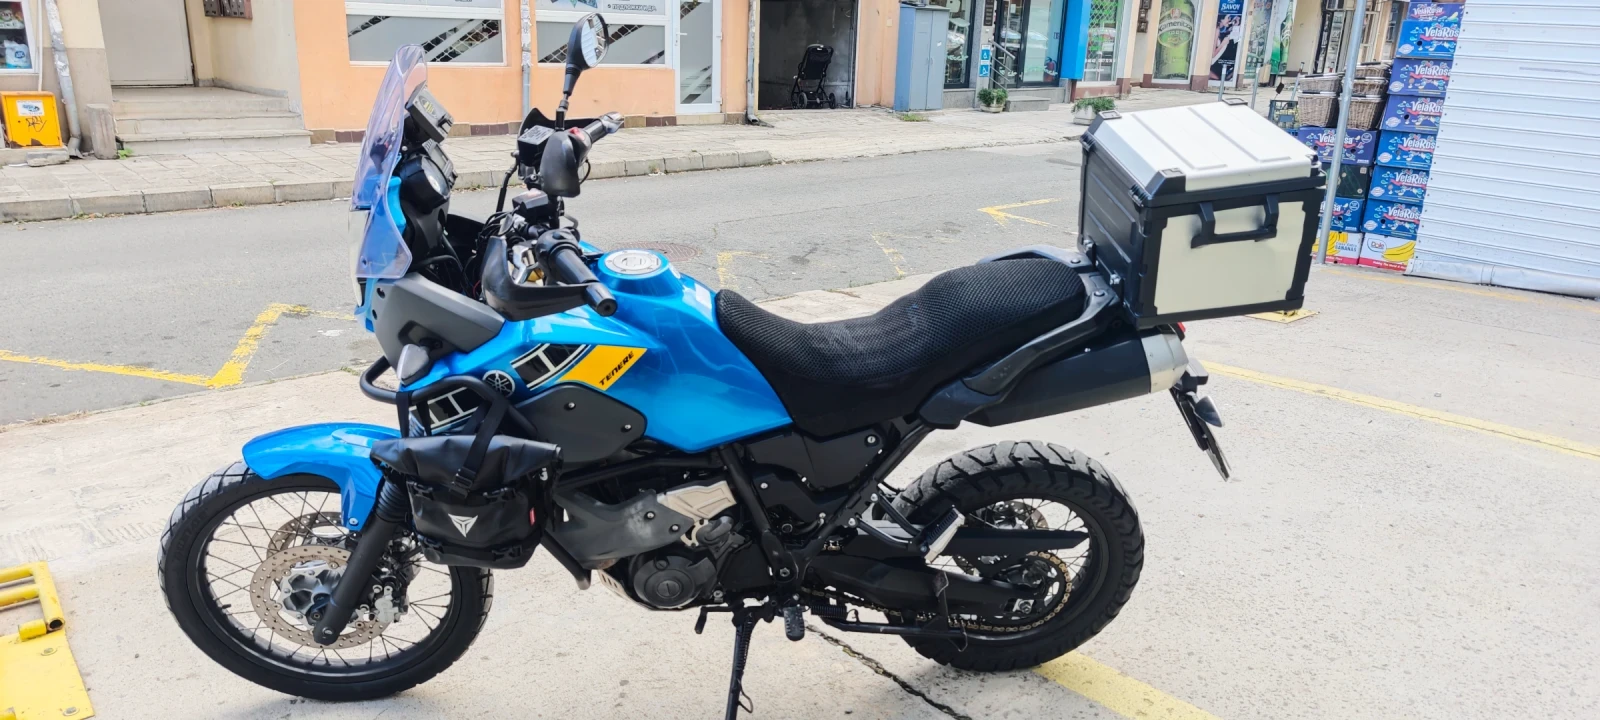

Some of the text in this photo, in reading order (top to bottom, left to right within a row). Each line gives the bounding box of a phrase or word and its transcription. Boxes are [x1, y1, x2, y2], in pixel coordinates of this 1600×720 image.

[1220, 3, 1240, 11] SAVOY
[1423, 26, 1459, 38] VelaRos
[1411, 101, 1444, 113] VelaRos
[1317, 133, 1354, 144] Velasa
[1402, 137, 1436, 149] VelaRos
[1394, 172, 1429, 185] VelaRos
[1387, 206, 1420, 220] VelaRos
[1370, 241, 1384, 249] Dole
[599, 351, 635, 386] TENERE
